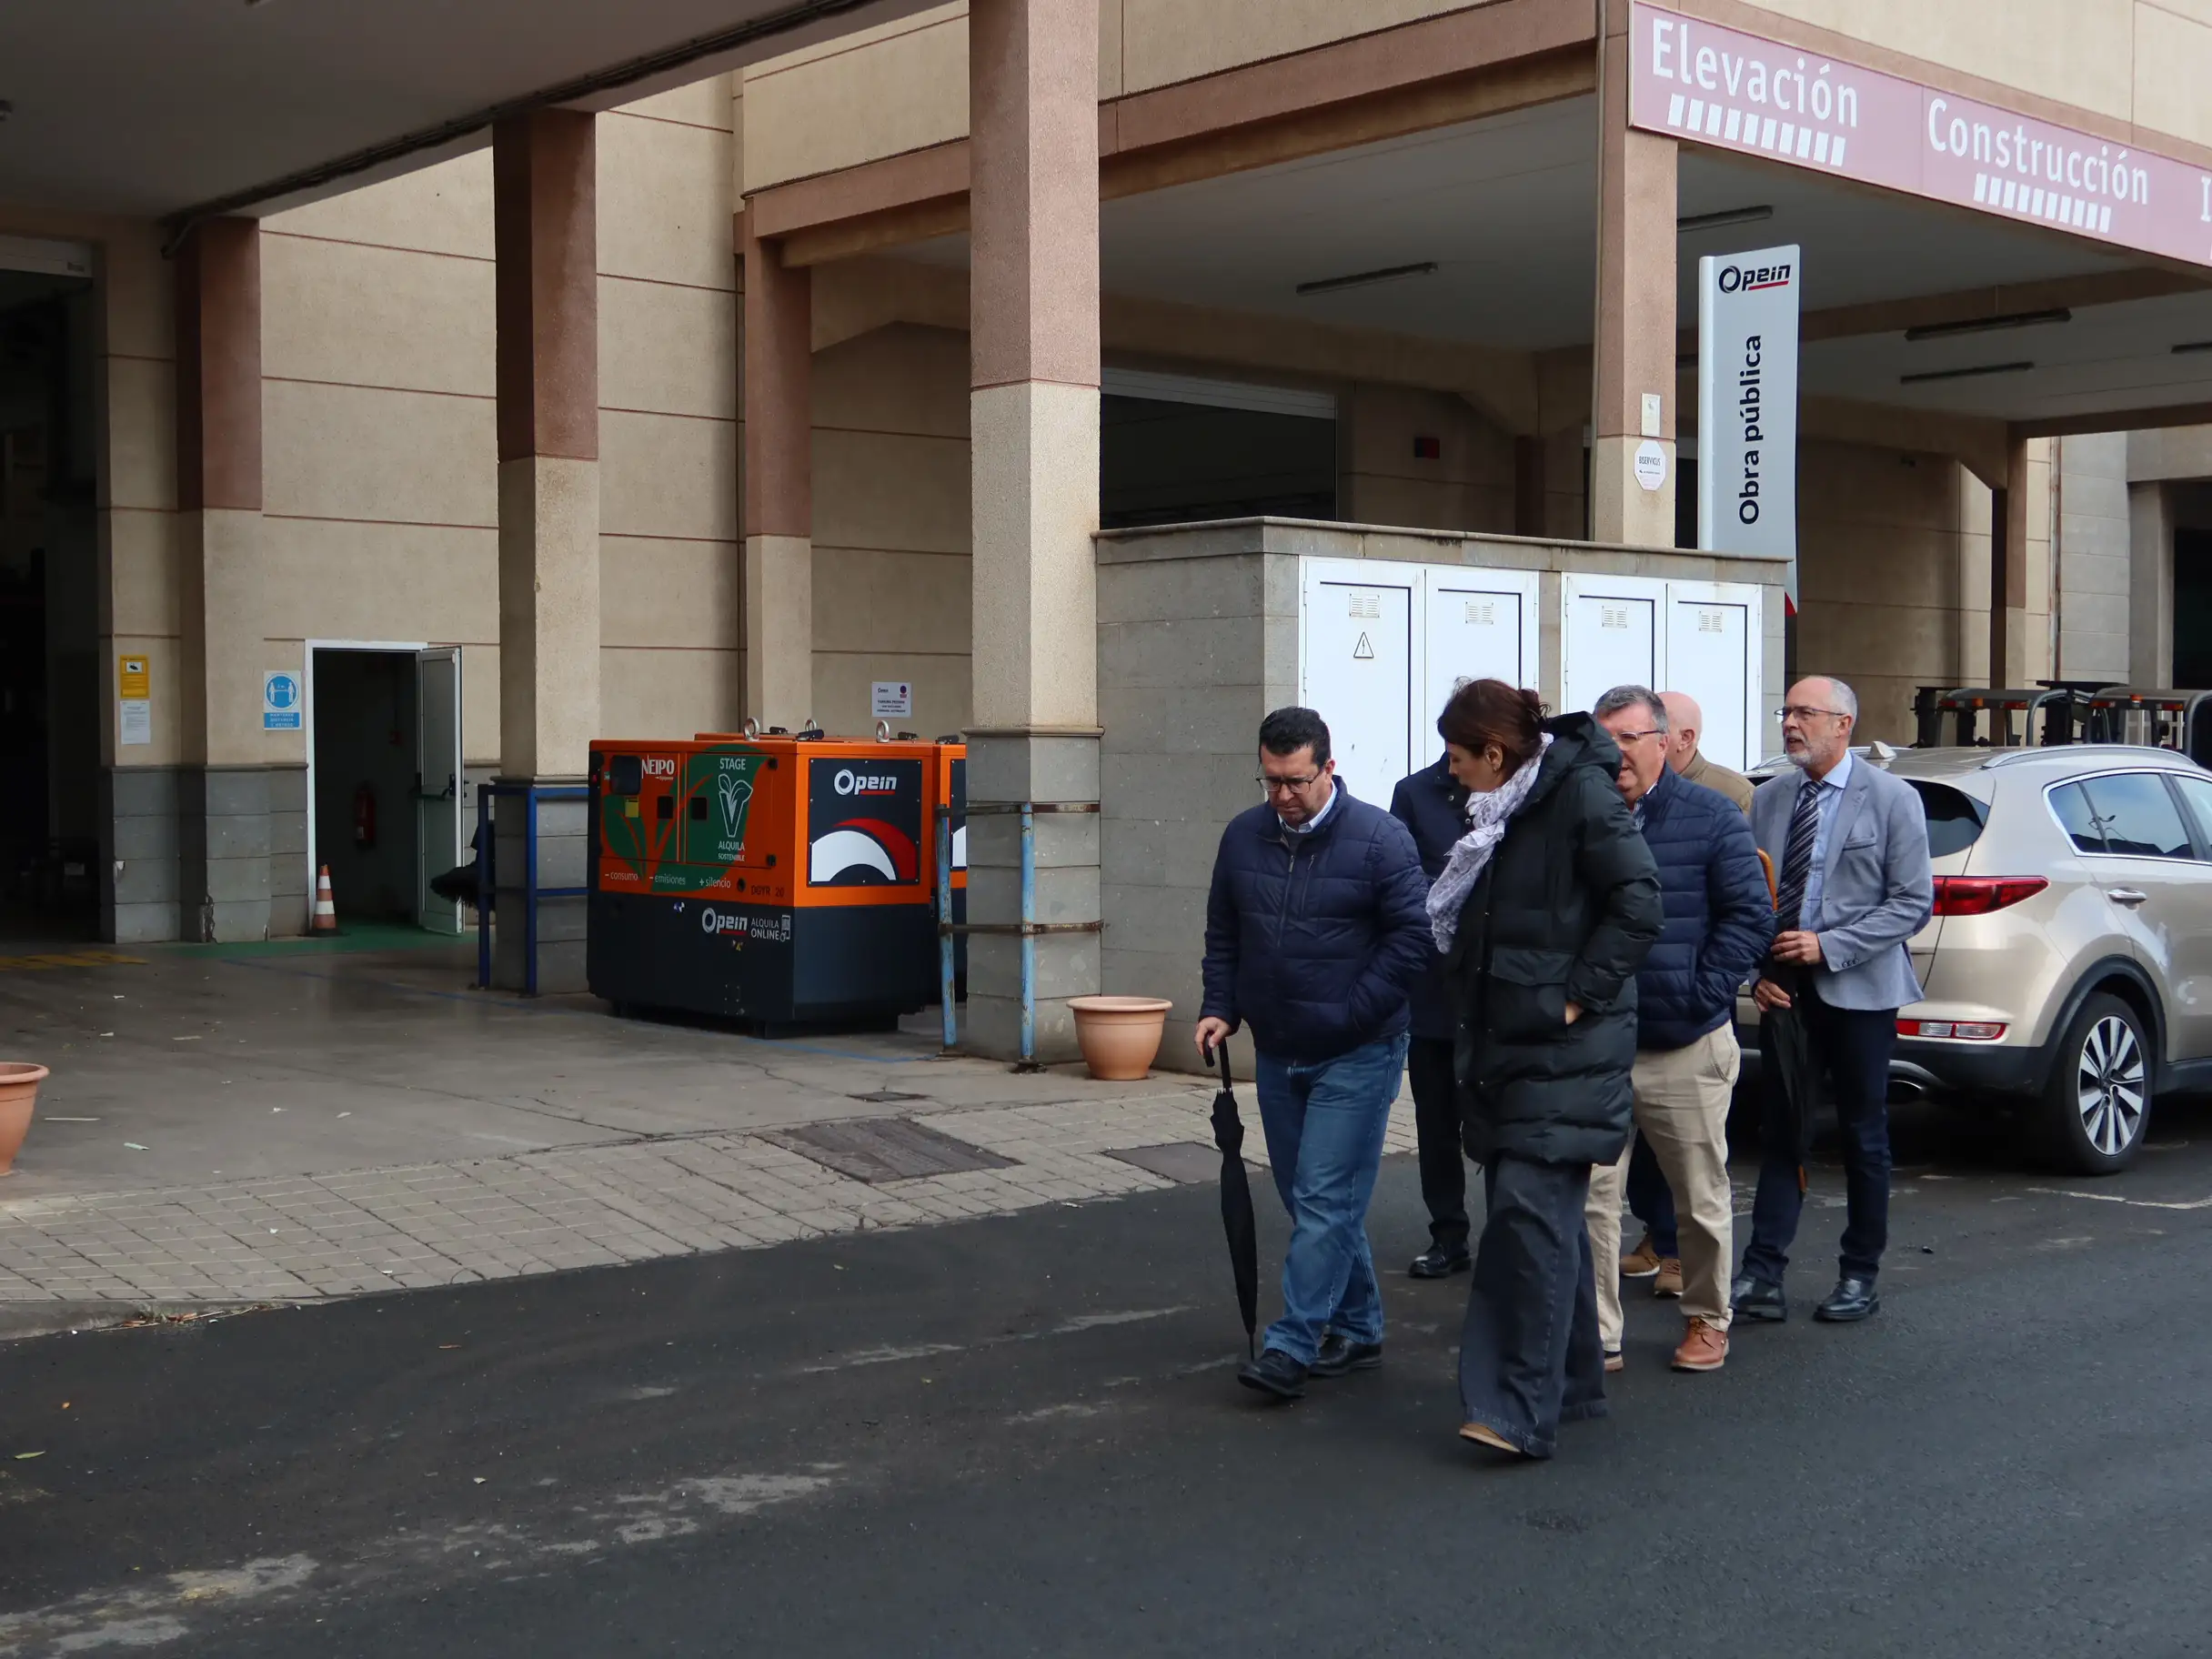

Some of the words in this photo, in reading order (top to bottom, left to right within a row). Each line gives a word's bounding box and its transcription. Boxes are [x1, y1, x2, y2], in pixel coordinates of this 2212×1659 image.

[1650, 17, 1858, 128] Elevación
[1927, 98, 2148, 206] Construcción
[1718, 264, 1791, 294] Opein
[1739, 334, 1764, 442] pública
[1739, 449, 1760, 525] Obra
[641, 755, 675, 779] NEIPO
[719, 758, 747, 770] STAGE
[834, 769, 898, 796] Opein
[718, 840, 745, 852] ALQUILA
[718, 852, 745, 861] SOSTENIBLE
[654, 874, 687, 886] emisiones
[705, 876, 731, 889] silencio
[701, 907, 748, 933] Opein
[750, 917, 779, 929] ALQUILA
[750, 928, 779, 940] ONLINE
